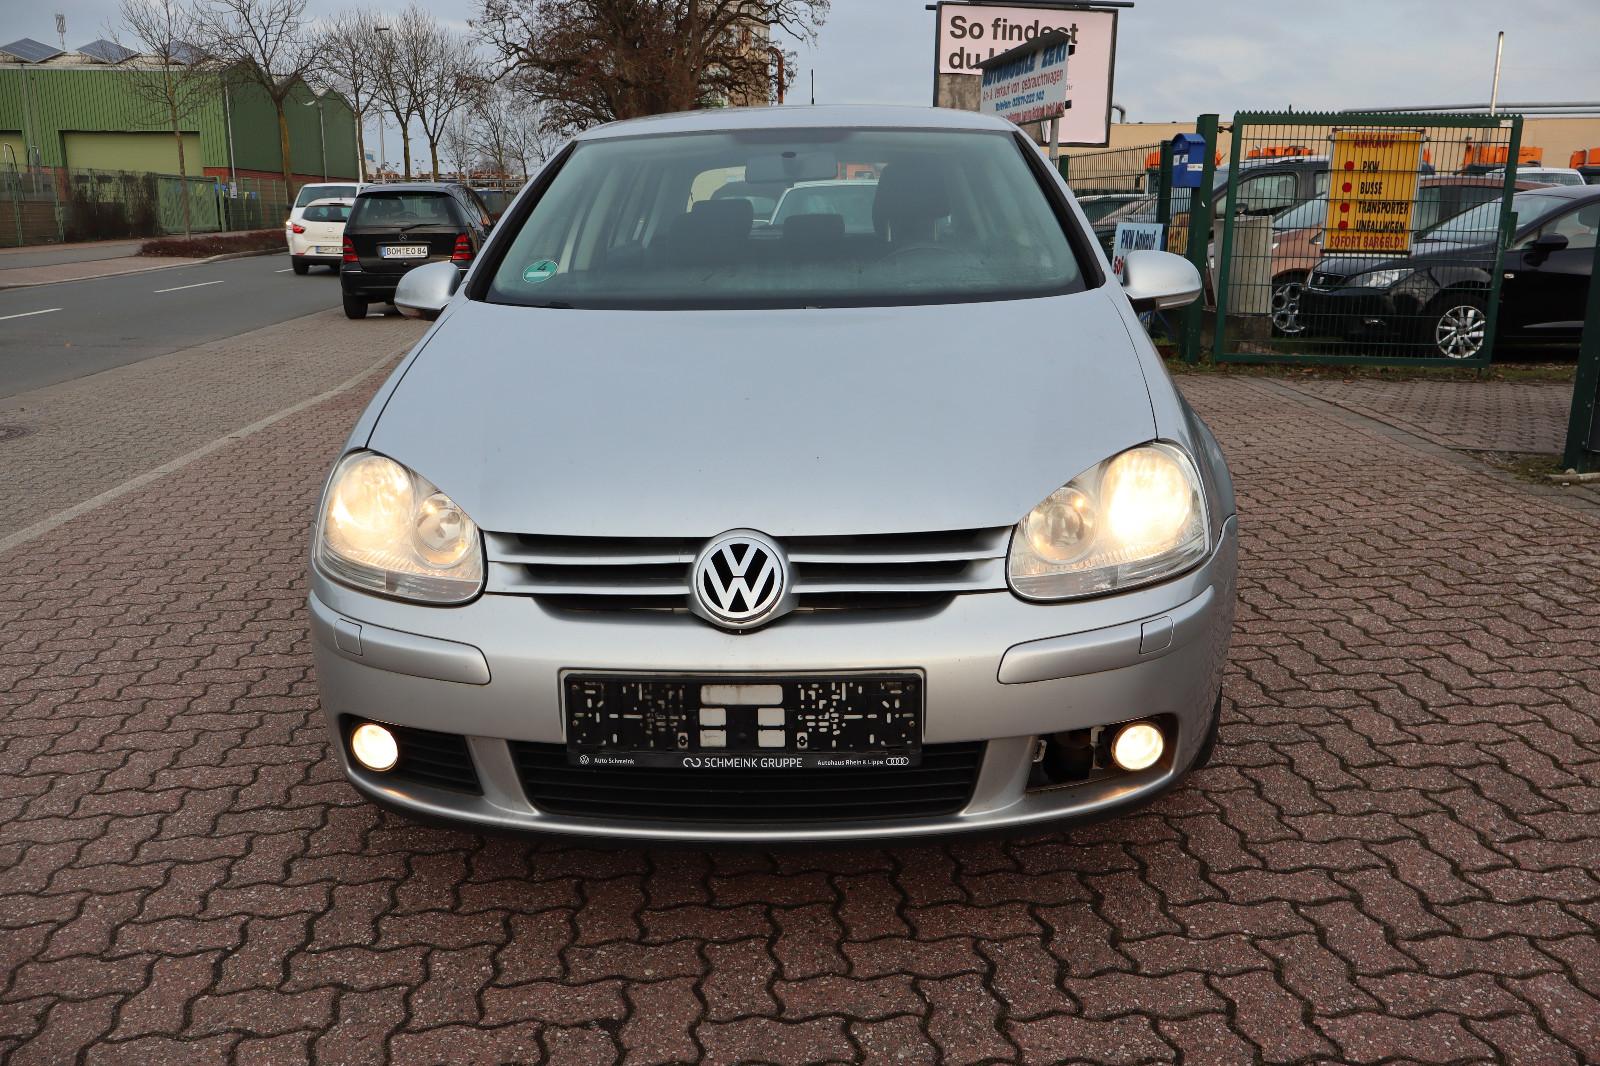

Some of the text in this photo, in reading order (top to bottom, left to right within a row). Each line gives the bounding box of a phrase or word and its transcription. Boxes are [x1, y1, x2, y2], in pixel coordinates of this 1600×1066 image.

[950, 15, 984, 40] So
[949, 46, 981, 70] du
[1011, 81, 1020, 95] von
[1362, 160, 1380, 174] PKW
[1360, 181, 1383, 195] BUSSE
[1357, 200, 1408, 215] TRANSPORTER
[1121, 229, 1135, 249] PKW
[1330, 234, 1362, 248] SOFORT
[386, 247, 402, 256] BOH
[417, 247, 427, 255] 84
[608, 757, 635, 765] Schmeink
[704, 757, 803, 768] SCHMEINK GRUPPE
[867, 759, 884, 767] Lippe
